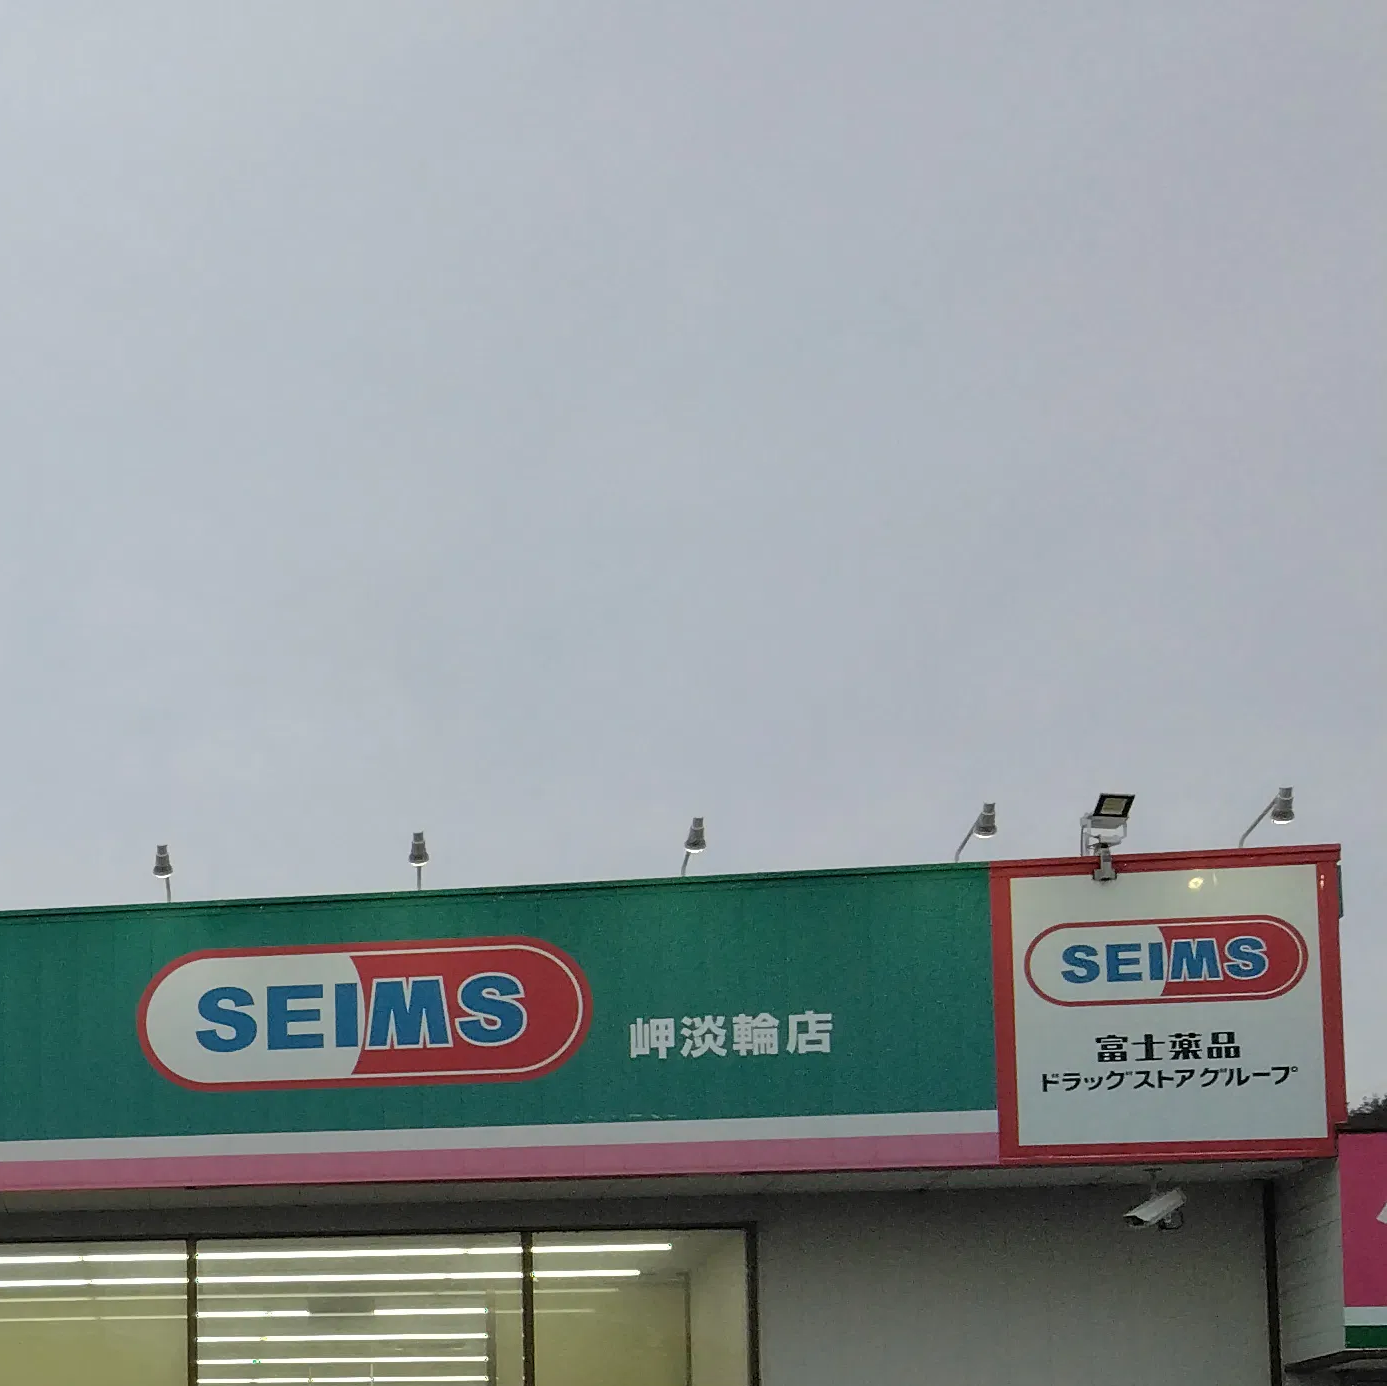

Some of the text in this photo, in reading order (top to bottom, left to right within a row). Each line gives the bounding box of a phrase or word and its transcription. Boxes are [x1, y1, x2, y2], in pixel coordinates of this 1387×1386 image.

[1061, 936, 1268, 984] SEIMS
[195, 972, 527, 1052] SEIMS
[628, 1010, 833, 1059] 岬淡輪店
[1095, 1031, 1241, 1063] 富士薬品
[1041, 1066, 1299, 1092] ドラッグストアグループ
